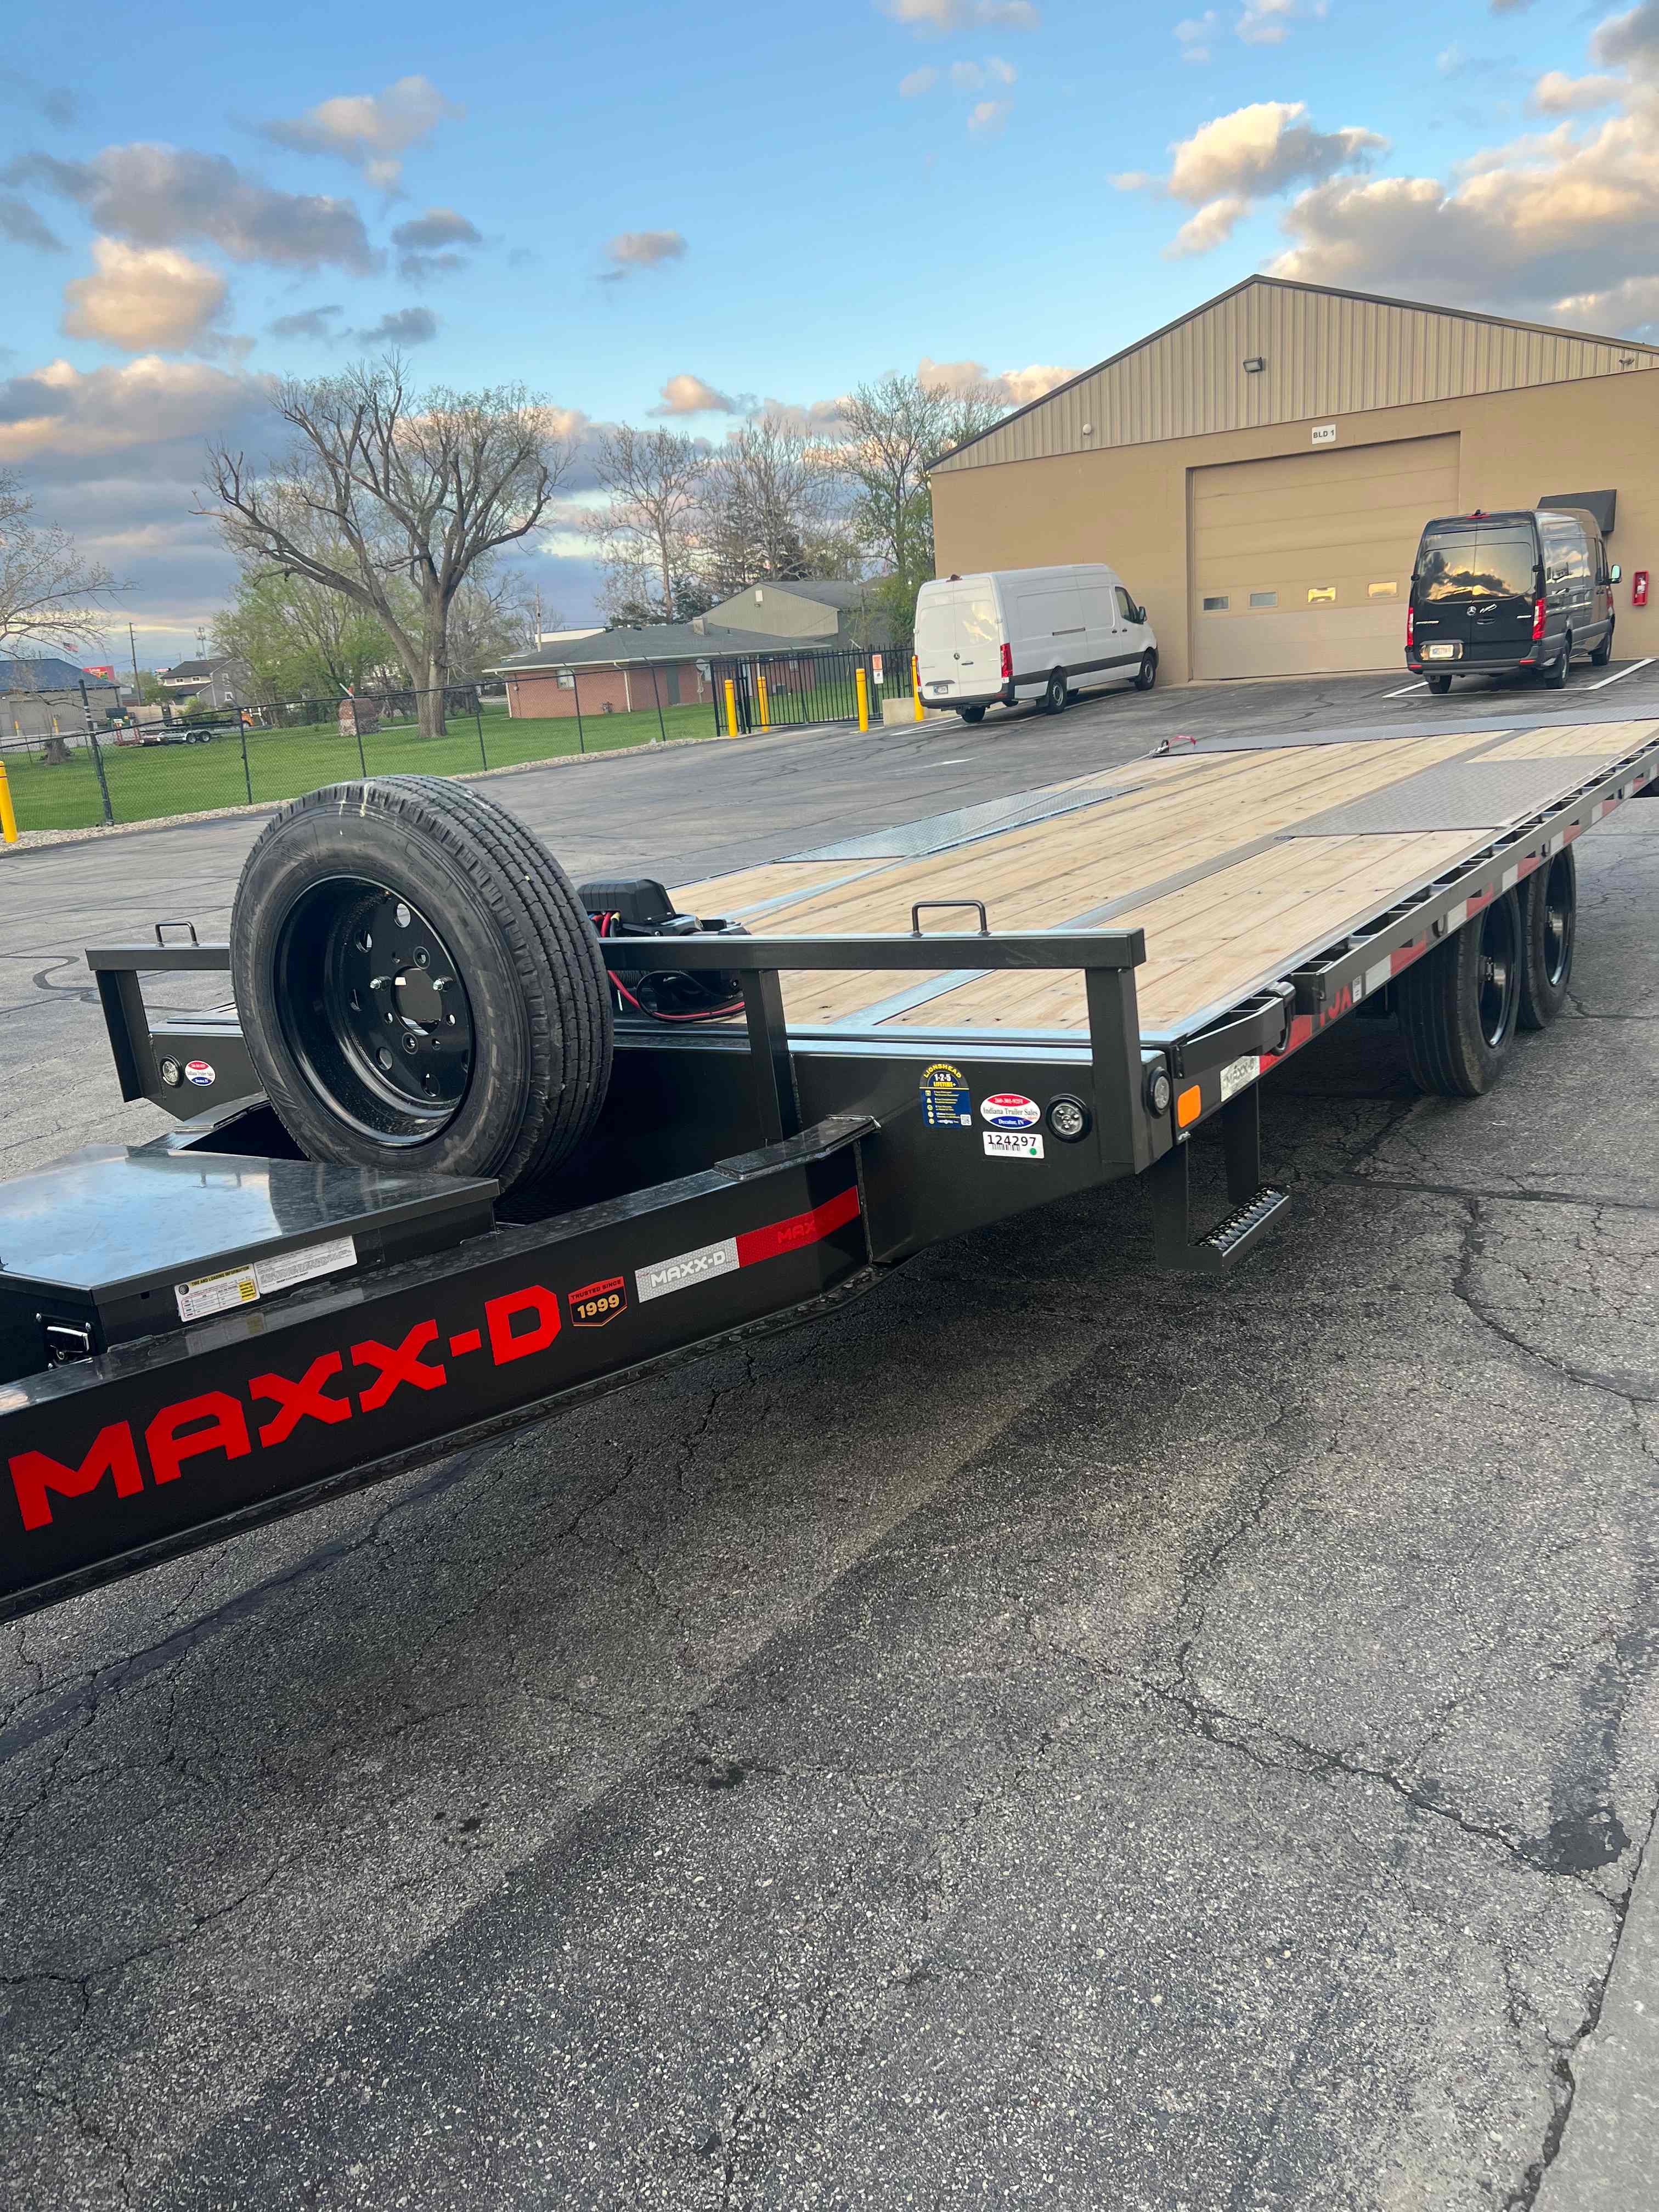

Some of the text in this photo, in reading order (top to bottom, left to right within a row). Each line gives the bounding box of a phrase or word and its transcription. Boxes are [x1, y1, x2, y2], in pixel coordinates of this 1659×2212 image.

[923, 1063, 962, 1079] LIONSHEAD
[988, 1135, 1036, 1147] 124297
[650, 1250, 726, 1288] MAXX-D
[571, 1279, 621, 1300] TRUSTED SINCE
[577, 1294, 619, 1318] 1999
[8, 1285, 561, 1531] MAXX-D
